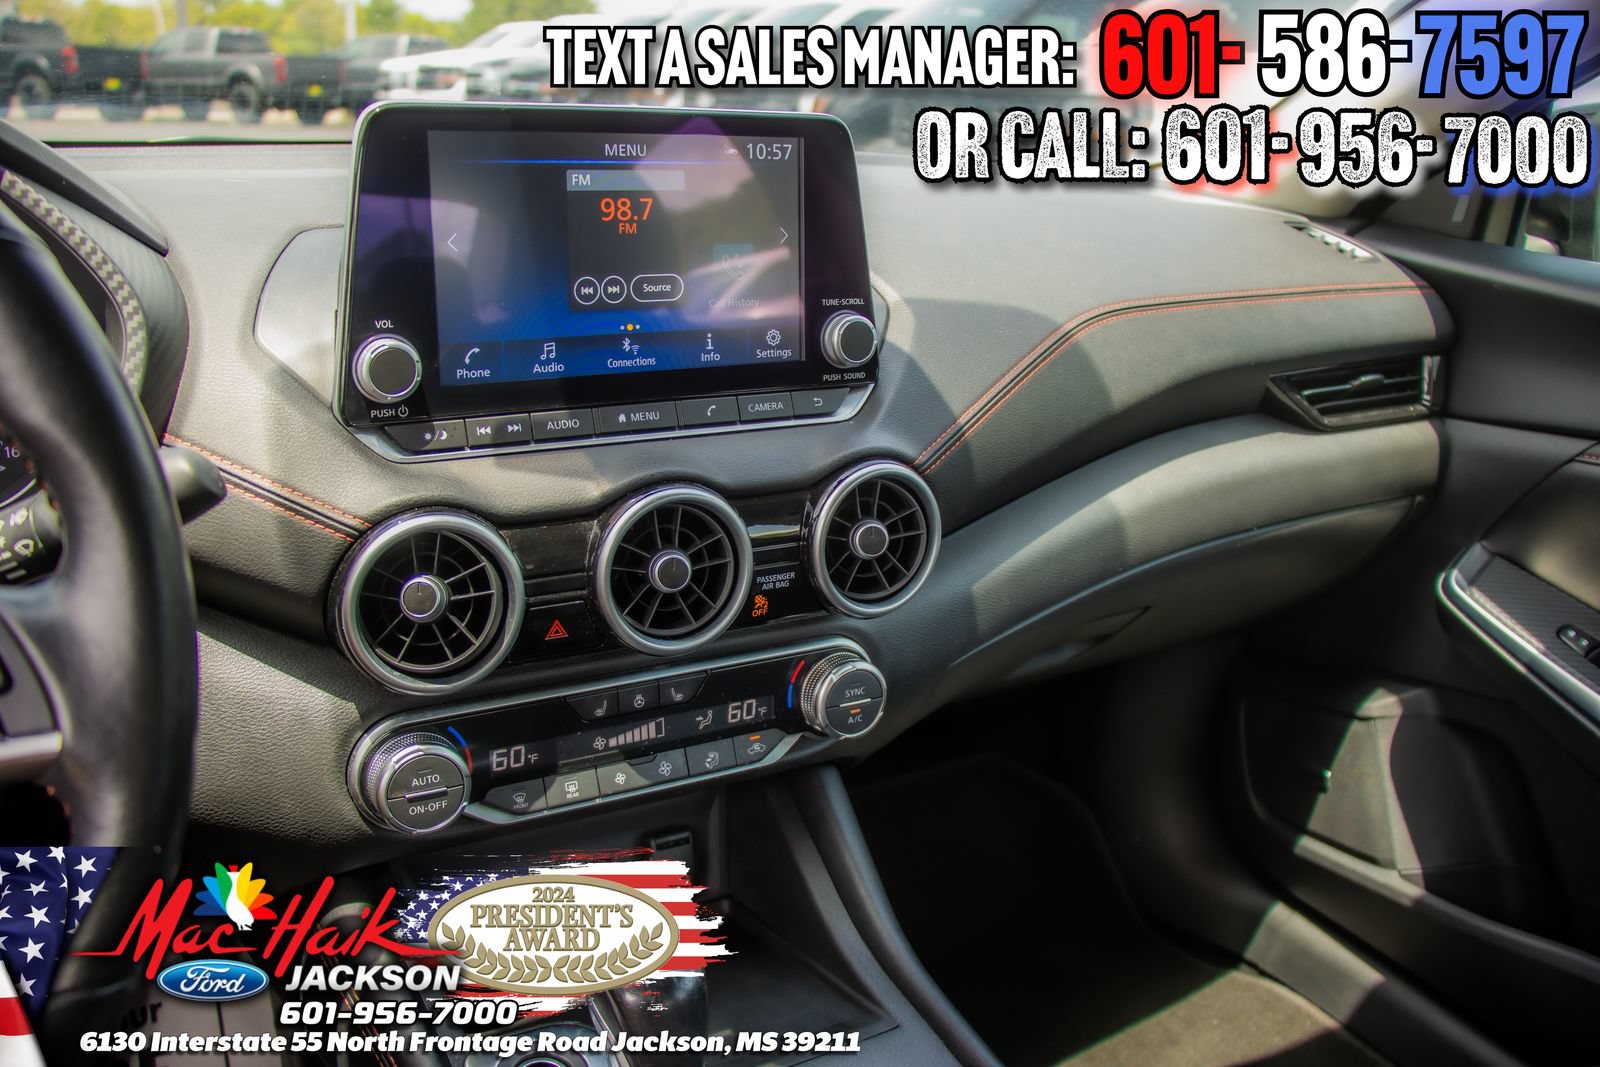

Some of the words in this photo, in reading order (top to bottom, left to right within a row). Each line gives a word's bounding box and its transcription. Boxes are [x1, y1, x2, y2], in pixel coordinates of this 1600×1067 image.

[604, 143, 647, 157] MENU
[746, 143, 793, 160] 10:57
[571, 174, 591, 187] FM
[600, 197, 654, 222] 98.7
[618, 223, 637, 234] FM
[643, 282, 672, 293] Source
[709, 298, 726, 308] Call
[729, 296, 760, 309] History
[375, 320, 394, 328] VOL
[701, 352, 721, 362] Info
[756, 348, 792, 360] Settings
[533, 362, 565, 374] Audio
[607, 356, 656, 369] Connections
[456, 367, 491, 379] Phone
[822, 374, 841, 382] PUSH
[843, 371, 866, 381] SOUND
[748, 401, 784, 412] CAMERA
[370, 409, 395, 418] PUSH
[630, 410, 660, 422] MENU
[546, 417, 580, 431] AUDIO
[4, 446, 20, 459] 16
[756, 571, 795, 584] PASSENGER
[761, 582, 774, 591] AIR
[775, 580, 790, 590] BAG
[752, 608, 769, 617] OFF
[845, 686, 866, 699] SYNC
[728, 699, 756, 724] 60
[847, 714, 863, 724] A/C
[492, 745, 525, 772] 60
[411, 774, 440, 788] AUTO
[566, 791, 580, 799] REAR
[513, 801, 529, 810] FRONT
